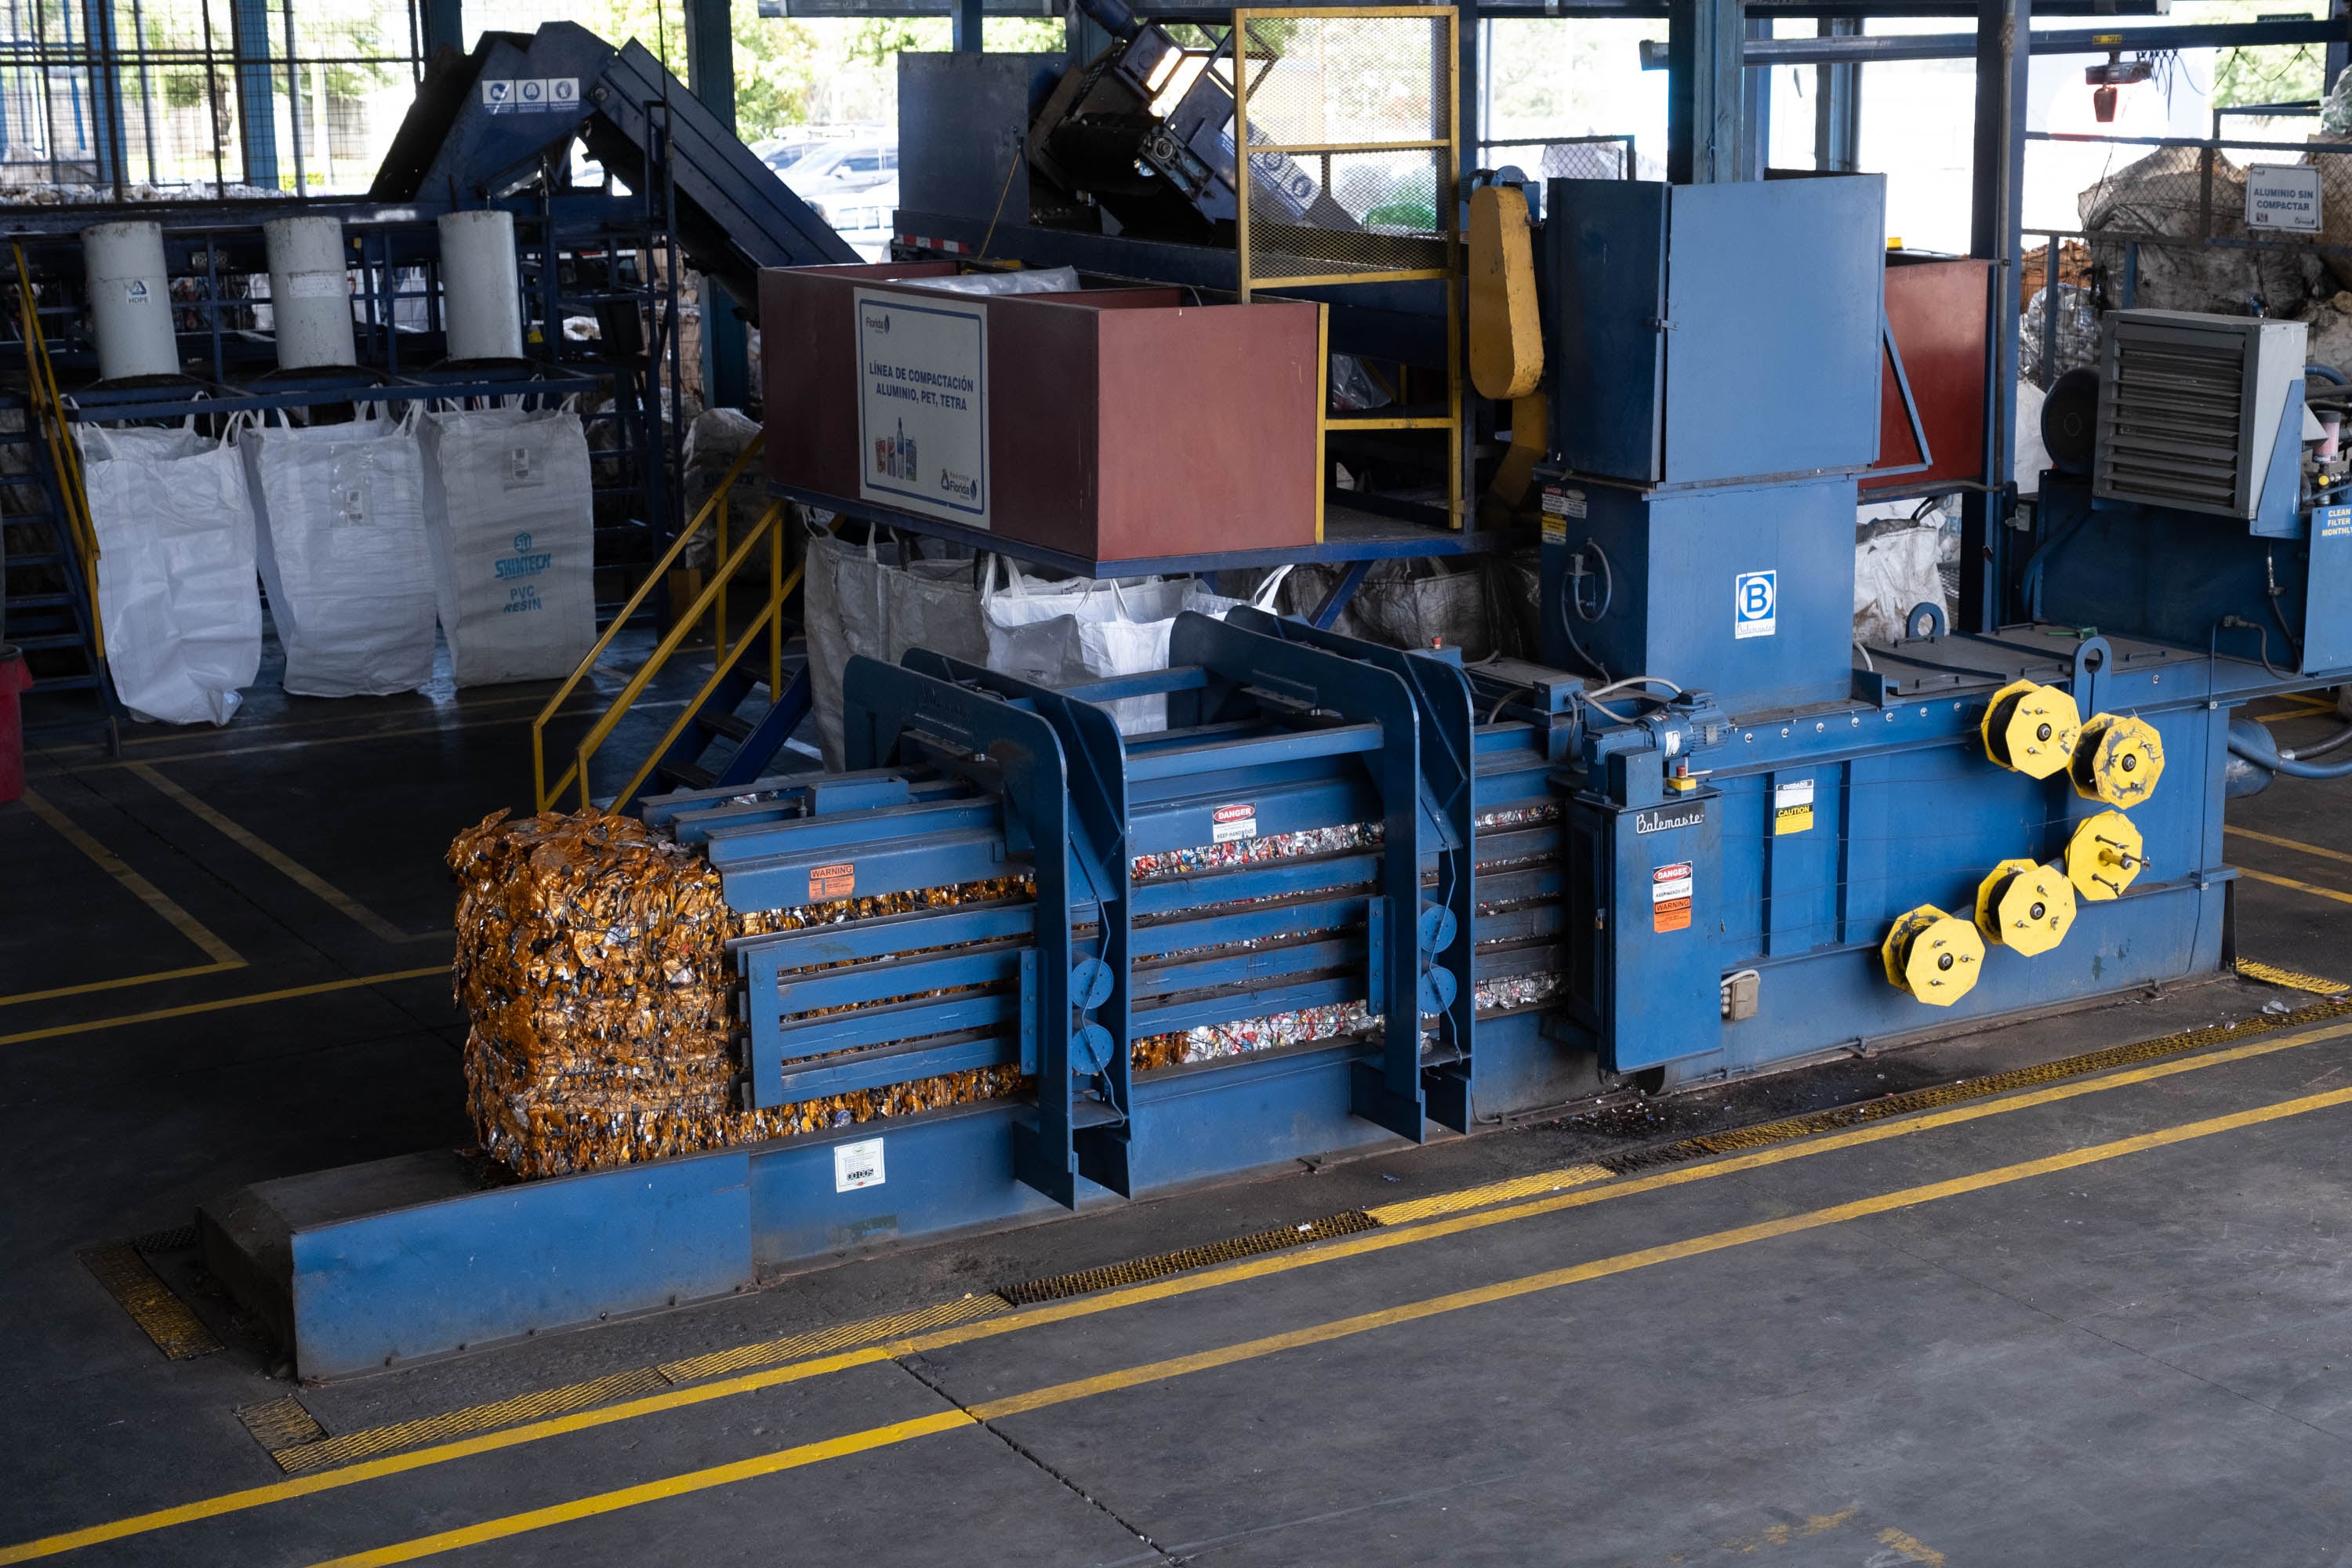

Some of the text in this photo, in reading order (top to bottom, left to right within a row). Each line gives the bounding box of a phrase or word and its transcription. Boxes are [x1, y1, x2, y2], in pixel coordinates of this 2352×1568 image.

[2254, 188, 2314, 199] ALUMINIO SIN
[2257, 200, 2310, 211] COMPACTAR
[869, 360, 974, 393] LÍNEA DE COMPACTACIÓN
[877, 383, 967, 411] ALUMINIO, PET, TETRA
[949, 481, 970, 495] Florida
[2328, 508, 2351, 517] CLEAN
[2327, 517, 2351, 527] FILTER
[2321, 526, 2352, 537] MONTHL
[495, 553, 551, 579] SHINTECH
[510, 585, 535, 601] PVC
[1747, 583, 1767, 612] B
[503, 597, 542, 613] RESIN
[1783, 781, 1808, 789] CUIDADO
[1218, 808, 1251, 820] DANGER
[1778, 806, 1809, 817] CAUTION
[811, 866, 852, 877] WARNING
[1657, 867, 1688, 879] DANGER
[1657, 900, 1690, 911] WARNING
